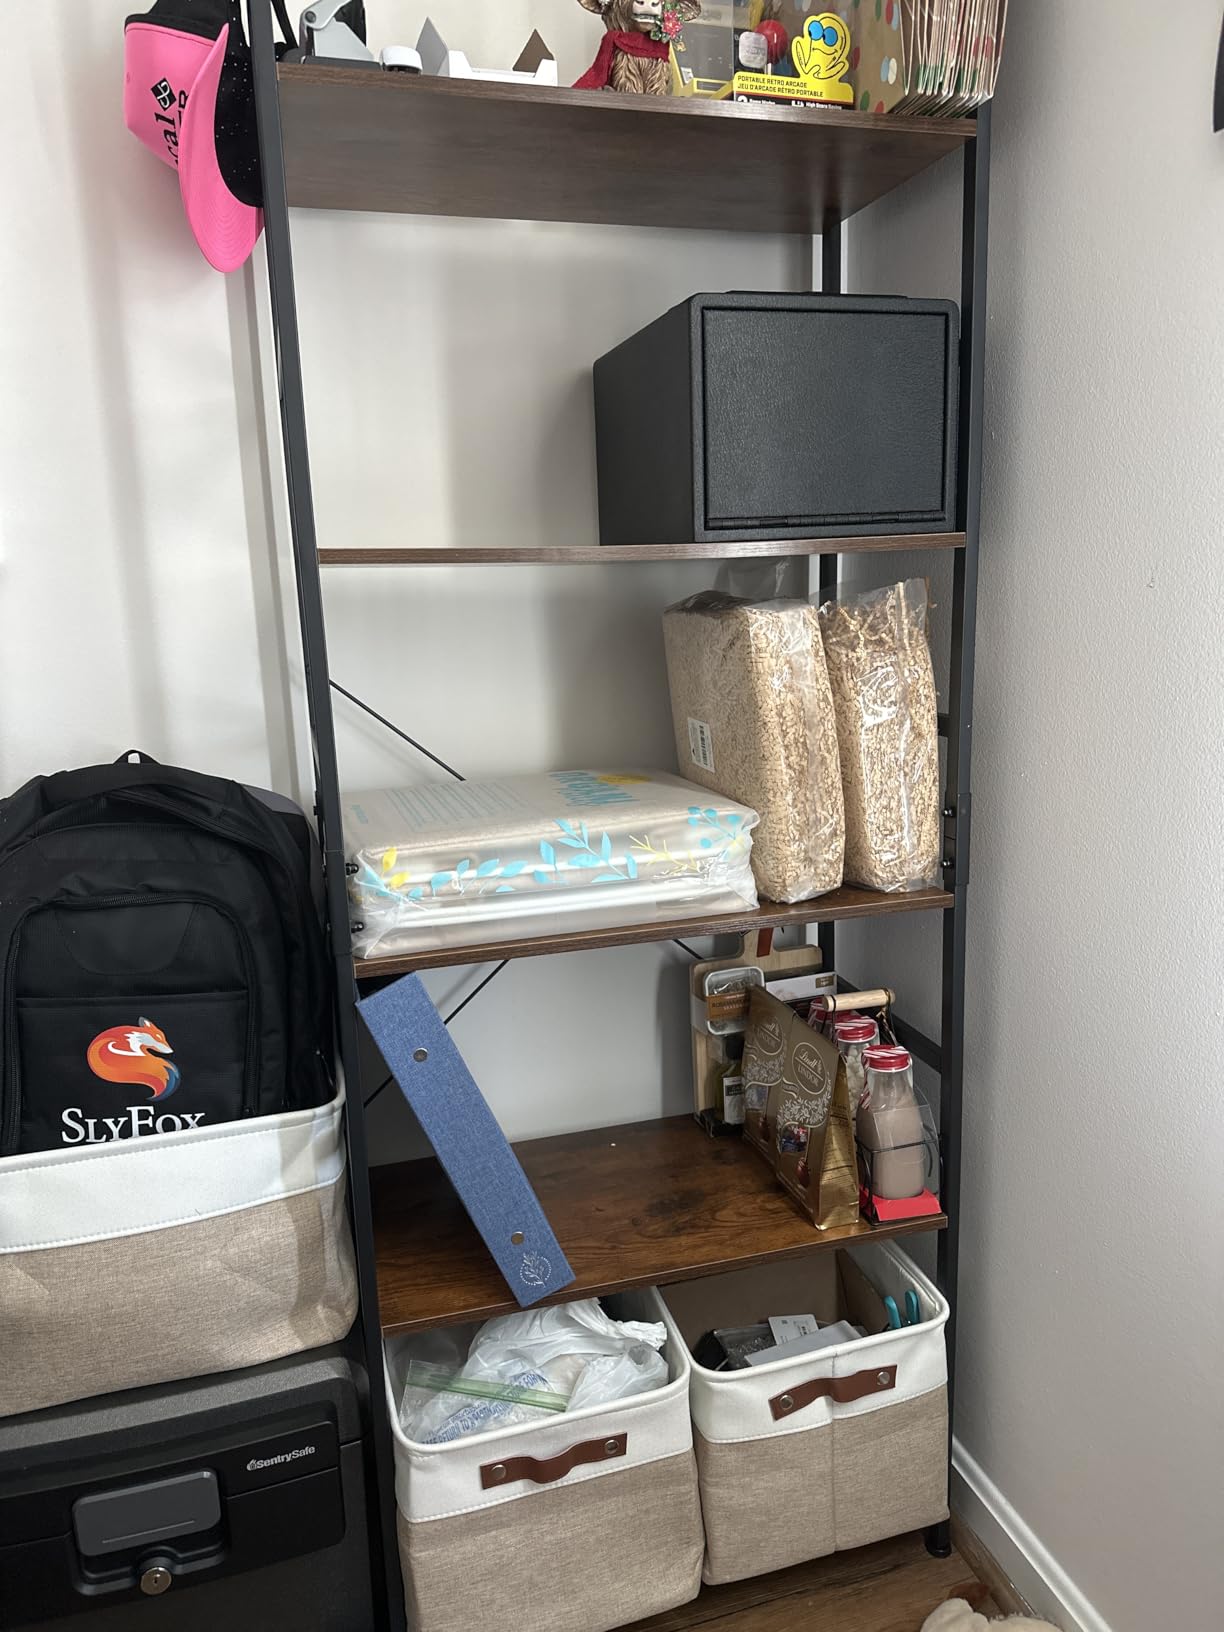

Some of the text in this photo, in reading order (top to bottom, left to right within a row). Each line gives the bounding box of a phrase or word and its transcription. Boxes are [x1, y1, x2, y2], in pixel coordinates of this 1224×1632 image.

[738, 75, 766, 84] PORTABLE
[767, 78, 785, 86] RETRO
[796, 89, 824, 98] PORTABLE
[256, 1446, 316, 1469] SentrySafe
